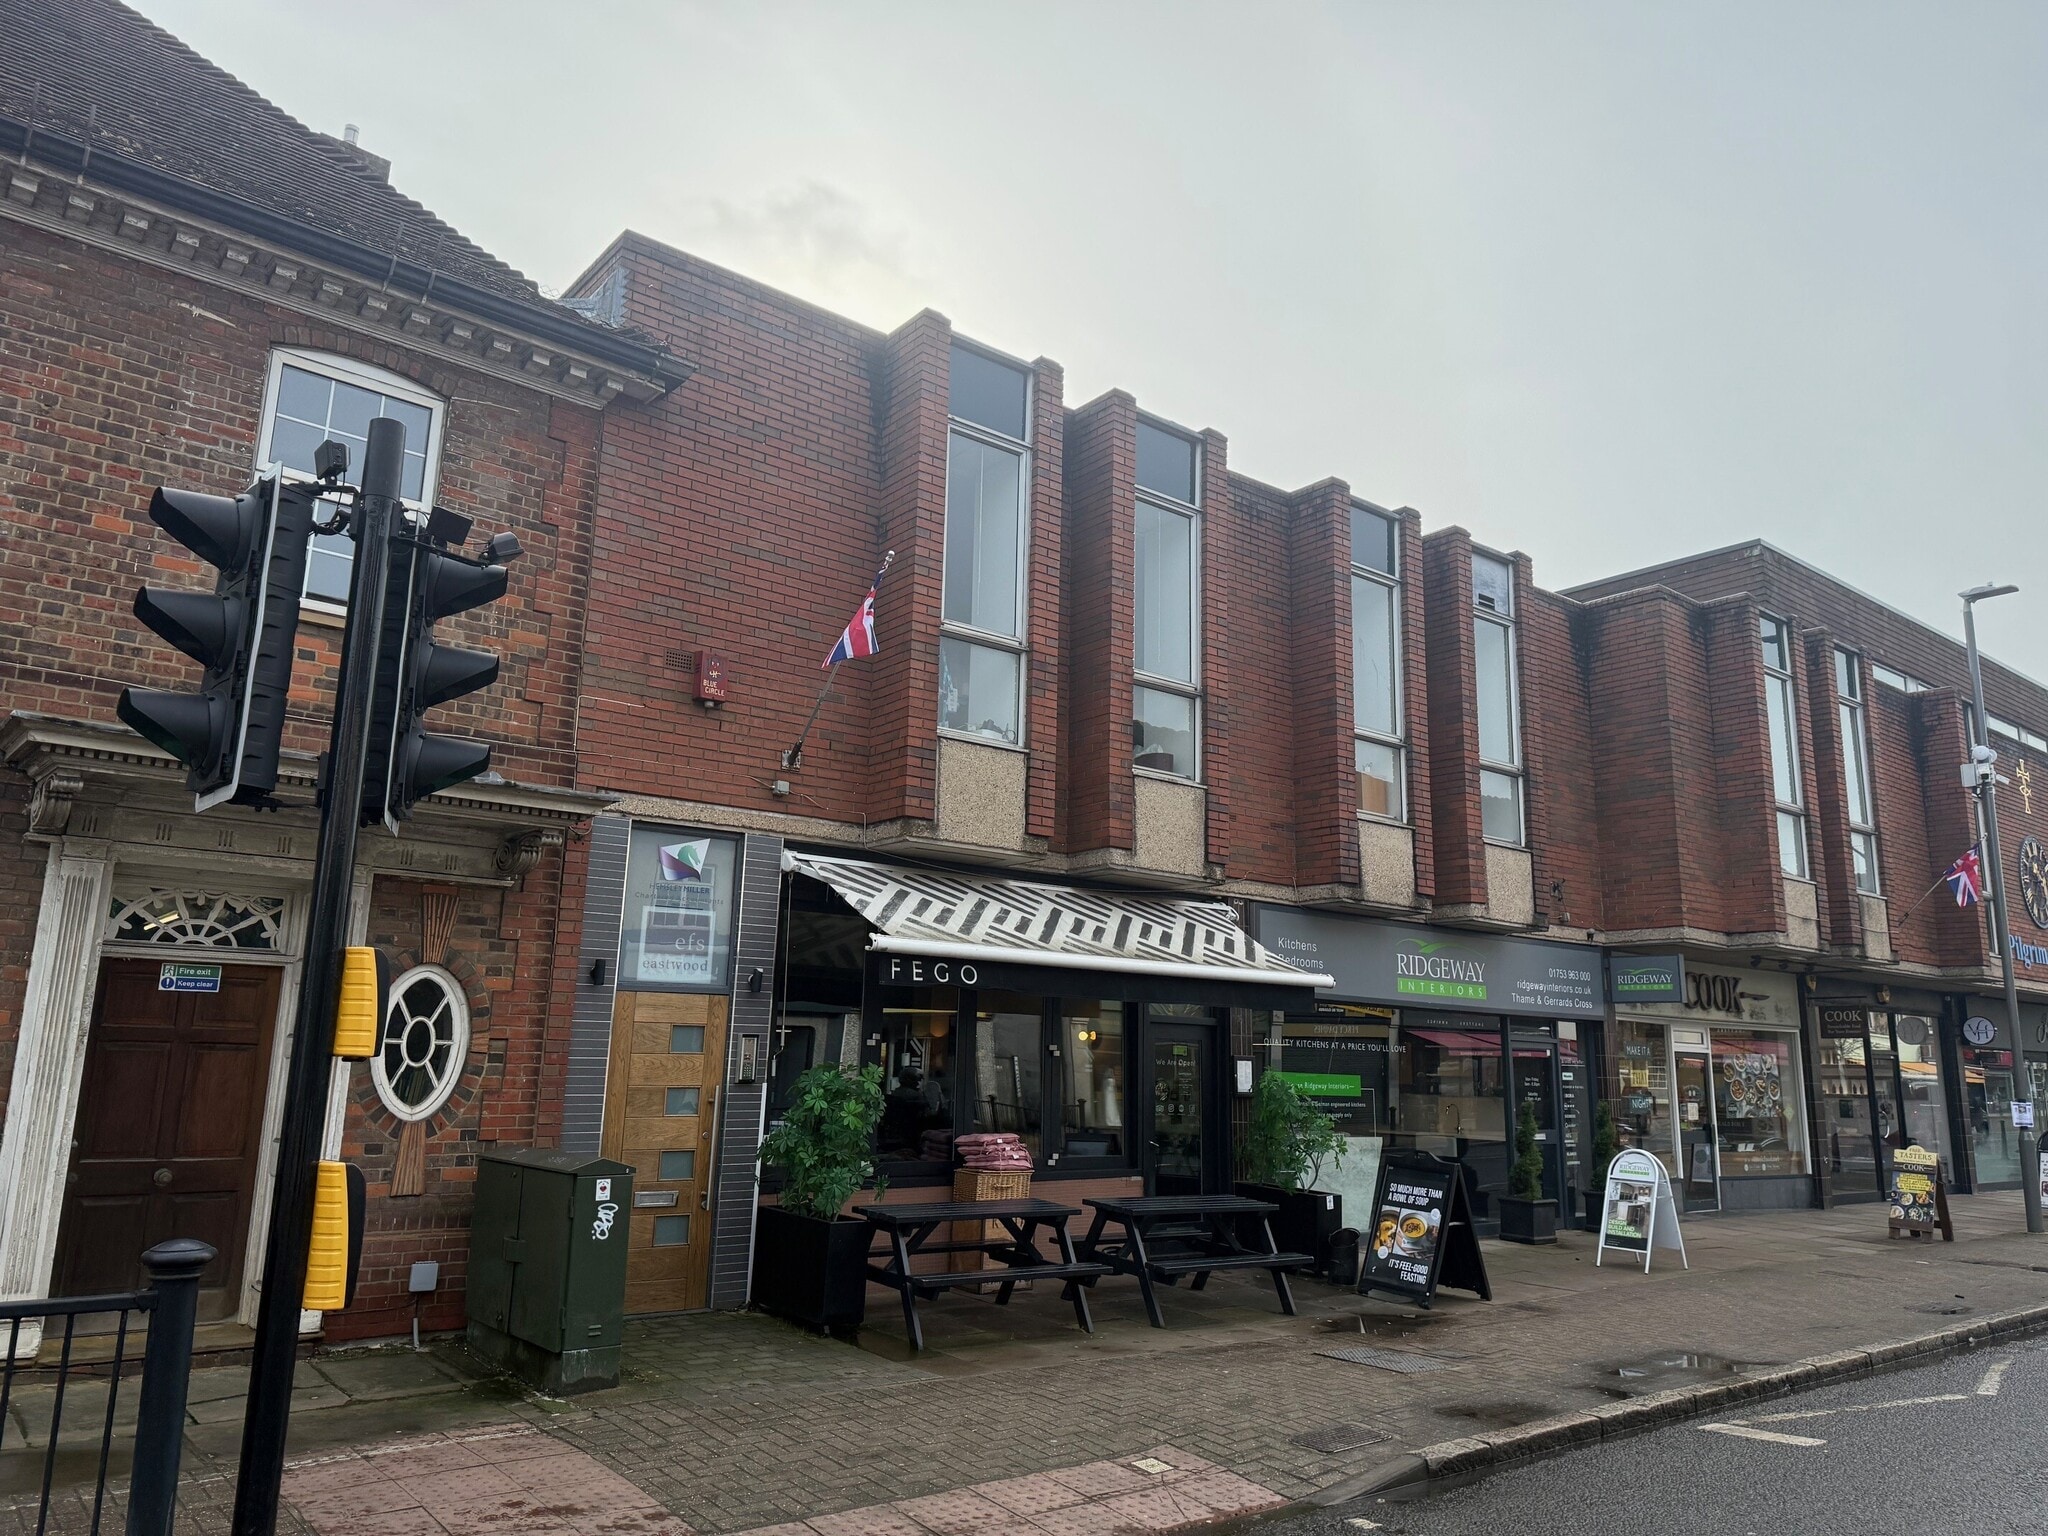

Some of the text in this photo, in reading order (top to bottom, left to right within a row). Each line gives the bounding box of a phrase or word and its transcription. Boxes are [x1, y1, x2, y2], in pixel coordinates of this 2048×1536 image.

[703, 679, 717, 688] BLUE
[705, 687, 724, 696] CIRCLE
[674, 932, 705, 951] efs
[1278, 937, 1318, 952] Kitchens
[180, 967, 195, 975] Fire
[642, 958, 709, 973] eastwood
[891, 959, 978, 985] FEGO
[1396, 953, 1486, 983] RIDGEWAY
[1549, 968, 1591, 981] 01753 963 000
[1617, 974, 1673, 985] RIDGEWAY
[1400, 981, 1483, 998] INTERIORS
[1516, 979, 1592, 995] ridgewayinteriors.co.uk
[1686, 972, 1745, 1013] COOK
[1511, 993, 1593, 1009] Thame & Gerrards Cross
[1824, 1010, 1862, 1022] COOK
[1263, 1037, 1294, 1047] QUALITY
[1296, 1039, 1329, 1049] KITCHENS
[1330, 1041, 1339, 1049] AT
[1348, 1042, 1366, 1051] PRICE
[1368, 1043, 1389, 1052] YOU'LL
[1390, 1044, 1406, 1053] LOVE
[1626, 1045, 1640, 1054] MAKE
[1641, 1046, 1646, 1055] IT
[1155, 1058, 1166, 1066] We
[1304, 1083, 1328, 1091] Ridgeway
[1899, 1151, 1932, 1161] TASTERS
[1902, 1163, 1925, 1172] COOK
[1389, 1183, 1443, 1199] SO MUCH MORE THAN
[1388, 1191, 1429, 1207] A BOWL OF SOUP
[1388, 1258, 1428, 1275] IT'S FEEL-GOOD
[1400, 1271, 1427, 1285] FEASTING
